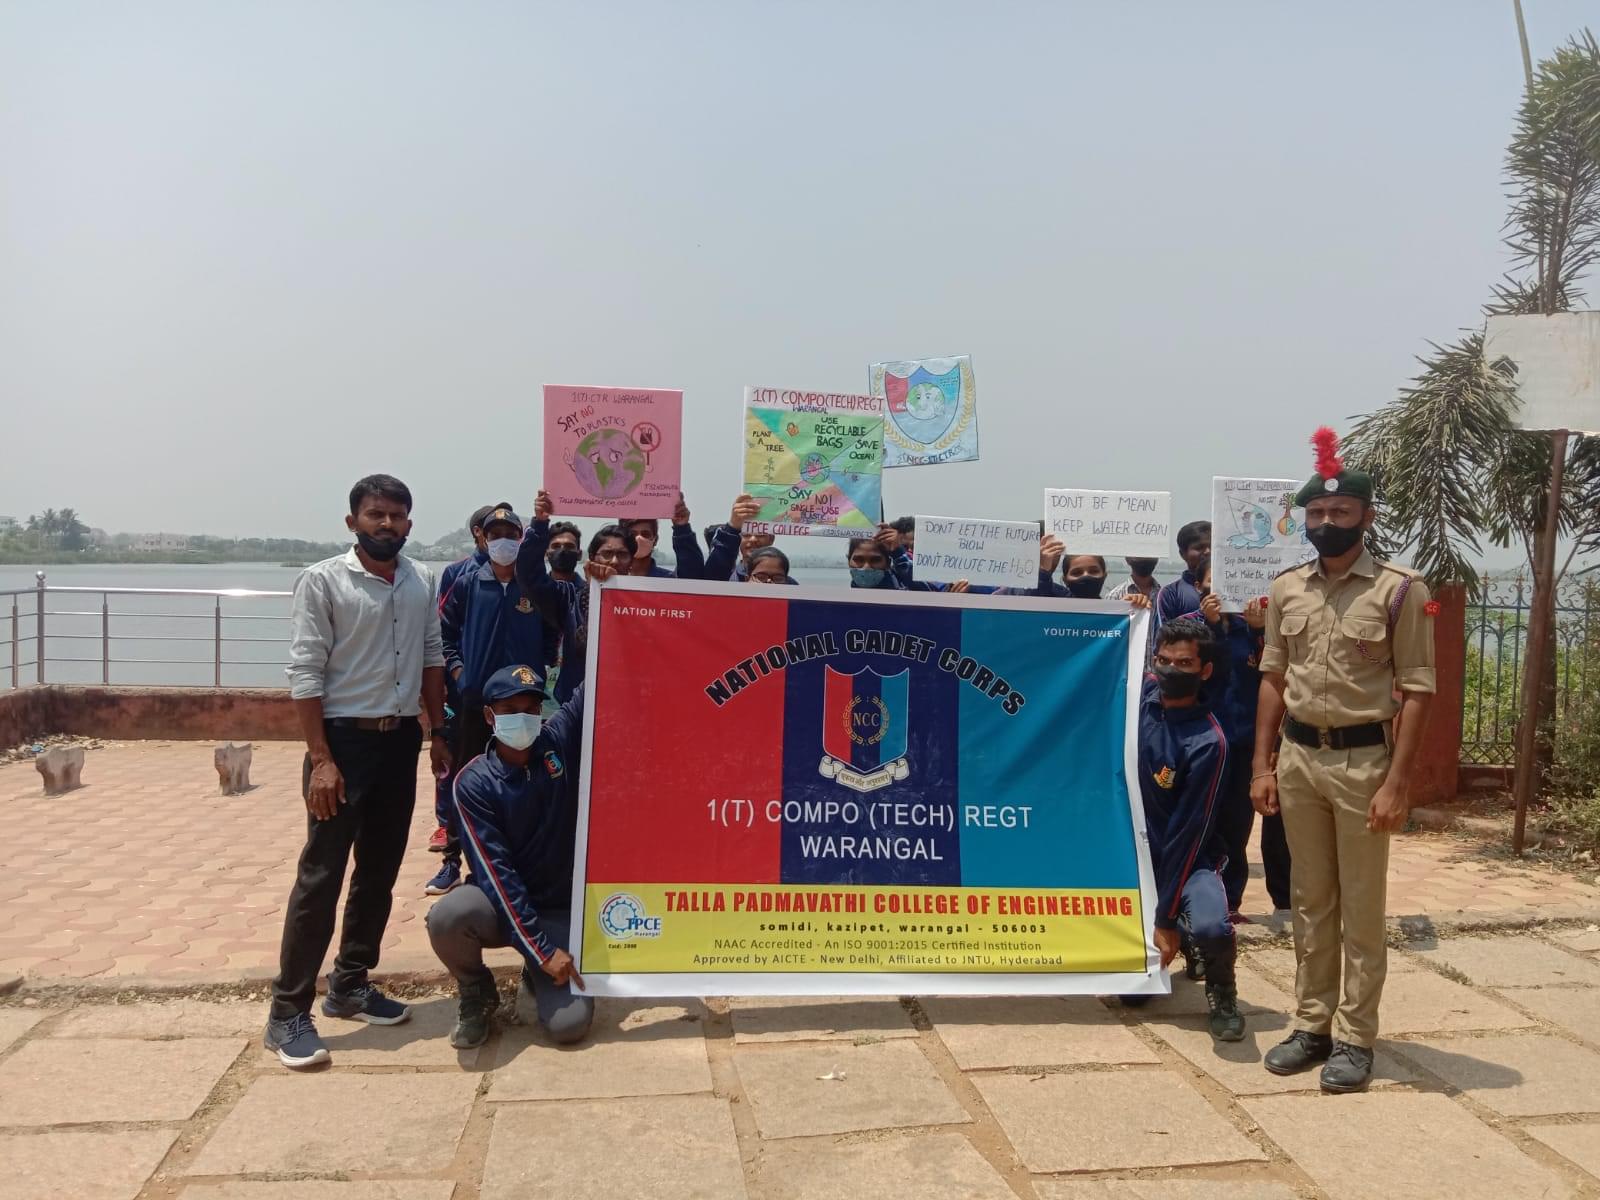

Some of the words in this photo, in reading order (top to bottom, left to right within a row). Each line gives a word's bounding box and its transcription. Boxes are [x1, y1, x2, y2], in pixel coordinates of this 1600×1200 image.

[557, 411, 580, 432] SAY
[580, 405, 595, 419] NO
[820, 417, 838, 425] USE
[573, 427, 587, 439] TO
[586, 415, 626, 432] PLASTICS
[814, 424, 866, 436] RECYCLABLE
[765, 444, 784, 452] TREE
[816, 436, 843, 449] BAGS
[855, 439, 879, 450] SAVE
[788, 486, 812, 500] SAY
[779, 497, 789, 505] TO
[1052, 495, 1084, 508] DONT
[1092, 496, 1110, 510] BE
[1117, 496, 1156, 511] MEAN
[745, 521, 769, 535] TPCE
[772, 524, 810, 536] COLLEGE
[925, 521, 954, 534] DONT
[958, 523, 977, 537] LET
[979, 524, 1000, 539] THE
[1005, 527, 1040, 541] FUTURE
[1053, 519, 1084, 532] KEEP
[1092, 521, 1130, 535] WATER
[1134, 522, 1168, 536] CLEAN
[943, 555, 986, 571] POLLUTE
[987, 559, 1009, 573] THE
[613, 606, 656, 617] NATION
[660, 609, 693, 619] FIRST
[1043, 627, 1079, 637] YOUTH
[1082, 629, 1122, 638] POWER
[704, 631, 839, 708] NATIONAL
[845, 629, 936, 664] CADET
[937, 648, 1026, 716] CORPS
[853, 713, 879, 727] NCC
[707, 799, 754, 827] 1(T)
[765, 800, 860, 824] COMPO
[869, 802, 954, 832] (TECH)
[965, 805, 1033, 828] REGT
[800, 835, 943, 860] WARANGAL
[665, 891, 726, 912] TALLA
[733, 892, 866, 913] PADMAVATHI
[873, 893, 960, 914] COLLEGE
[967, 894, 990, 915] OF
[998, 895, 1133, 916] ENGINEERING
[625, 917, 661, 931] TPCE
[760, 922, 818, 933] somidi,
[827, 922, 891, 934] kazipet,
[899, 924, 969, 935] warangal
[992, 924, 1046, 933] 506003
[714, 939, 746, 949] NAAC
[750, 939, 813, 949] Accredited
[824, 940, 839, 949] An
[843, 940, 862, 950] ISO
[866, 940, 927, 950] 9001:2015
[931, 941, 980, 950] Certified
[984, 941, 1042, 951] Institution
[693, 954, 750, 965] Approved
[755, 954, 768, 965] by
[772, 954, 806, 964] AICTE
[820, 954, 845, 964] New
[850, 954, 884, 965] Delhi,
[888, 954, 941, 964] Affiliated
[945, 956, 957, 964] to
[962, 956, 995, 966] JNTU,
[1000, 955, 1063, 967] Hyderabad
